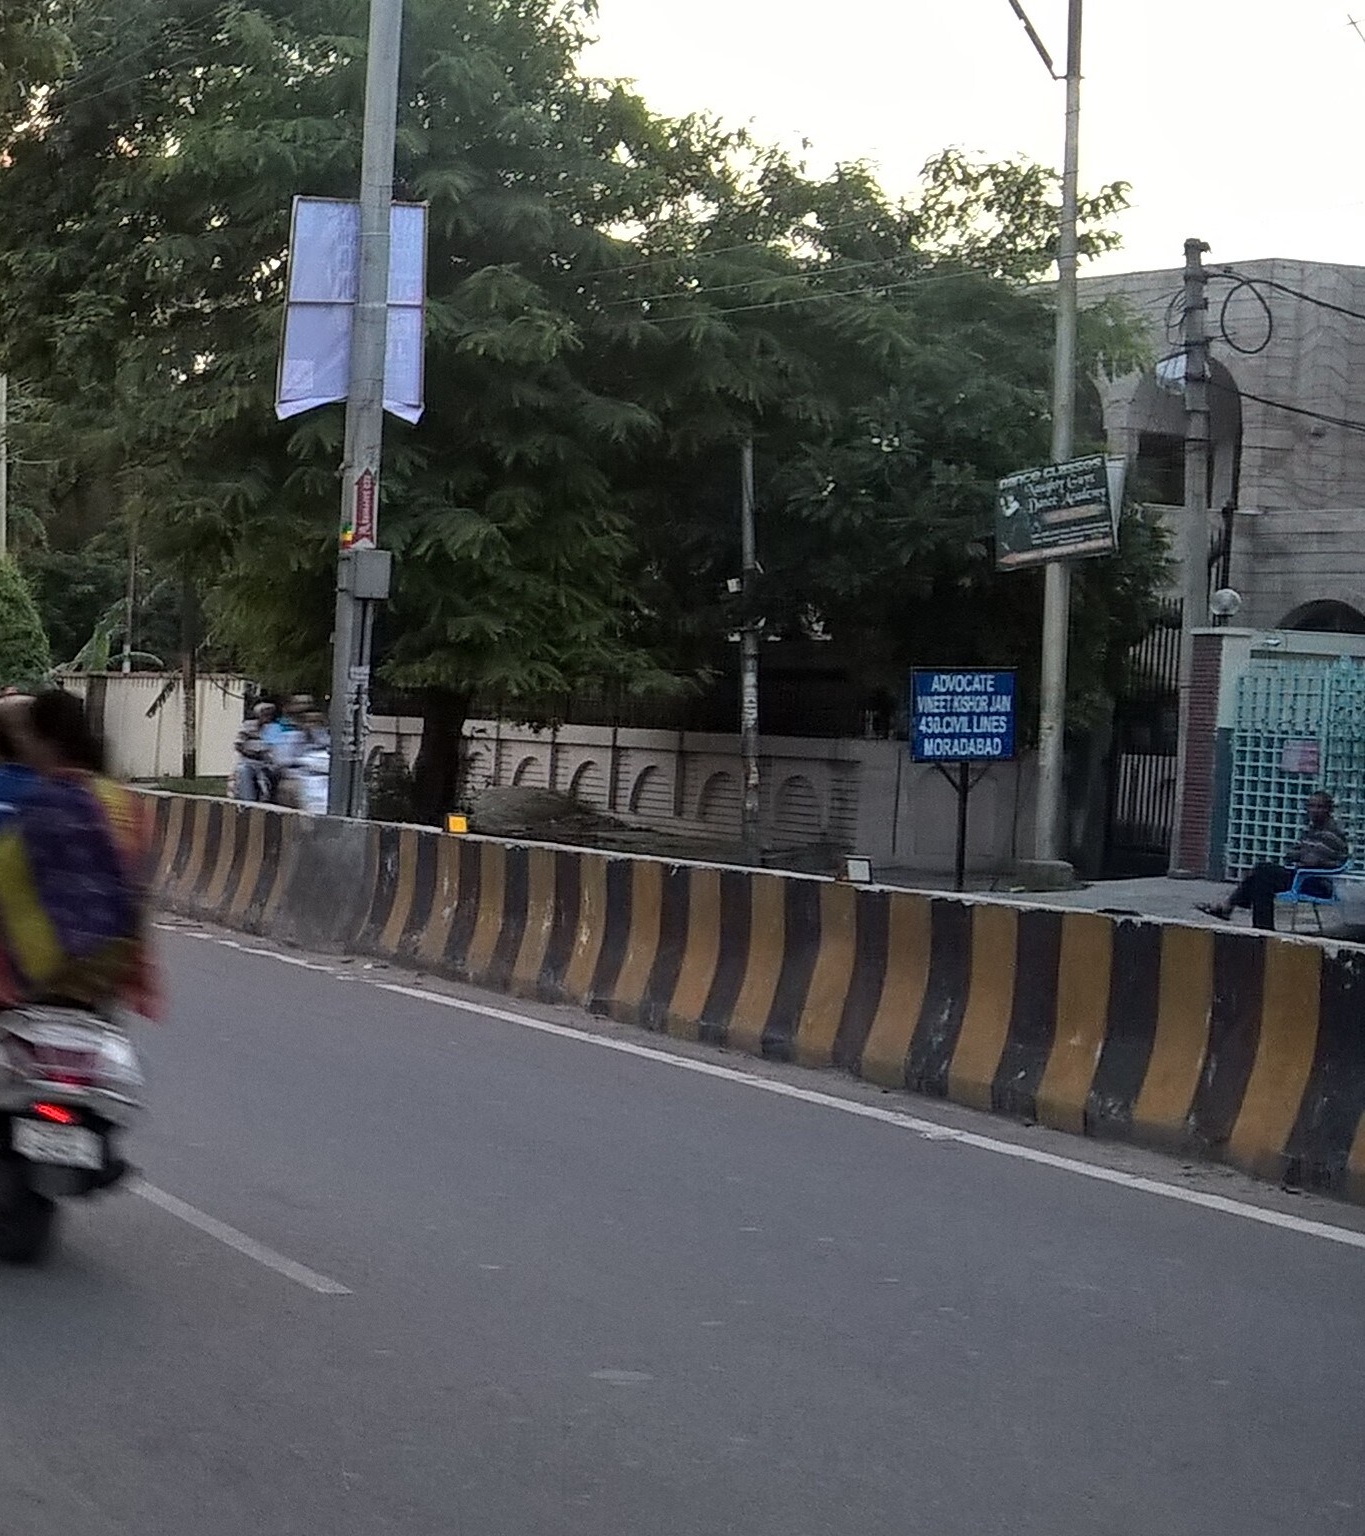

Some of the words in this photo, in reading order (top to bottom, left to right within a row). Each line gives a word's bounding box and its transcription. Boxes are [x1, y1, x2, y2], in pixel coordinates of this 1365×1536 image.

[931, 674, 995, 692] ADVOCATE
[917, 695, 952, 713] VINEET
[952, 695, 989, 712] KISHOR
[989, 695, 1011, 712] JAIN
[973, 715, 1007, 733] LINES
[923, 737, 1002, 756] MORADABAD
